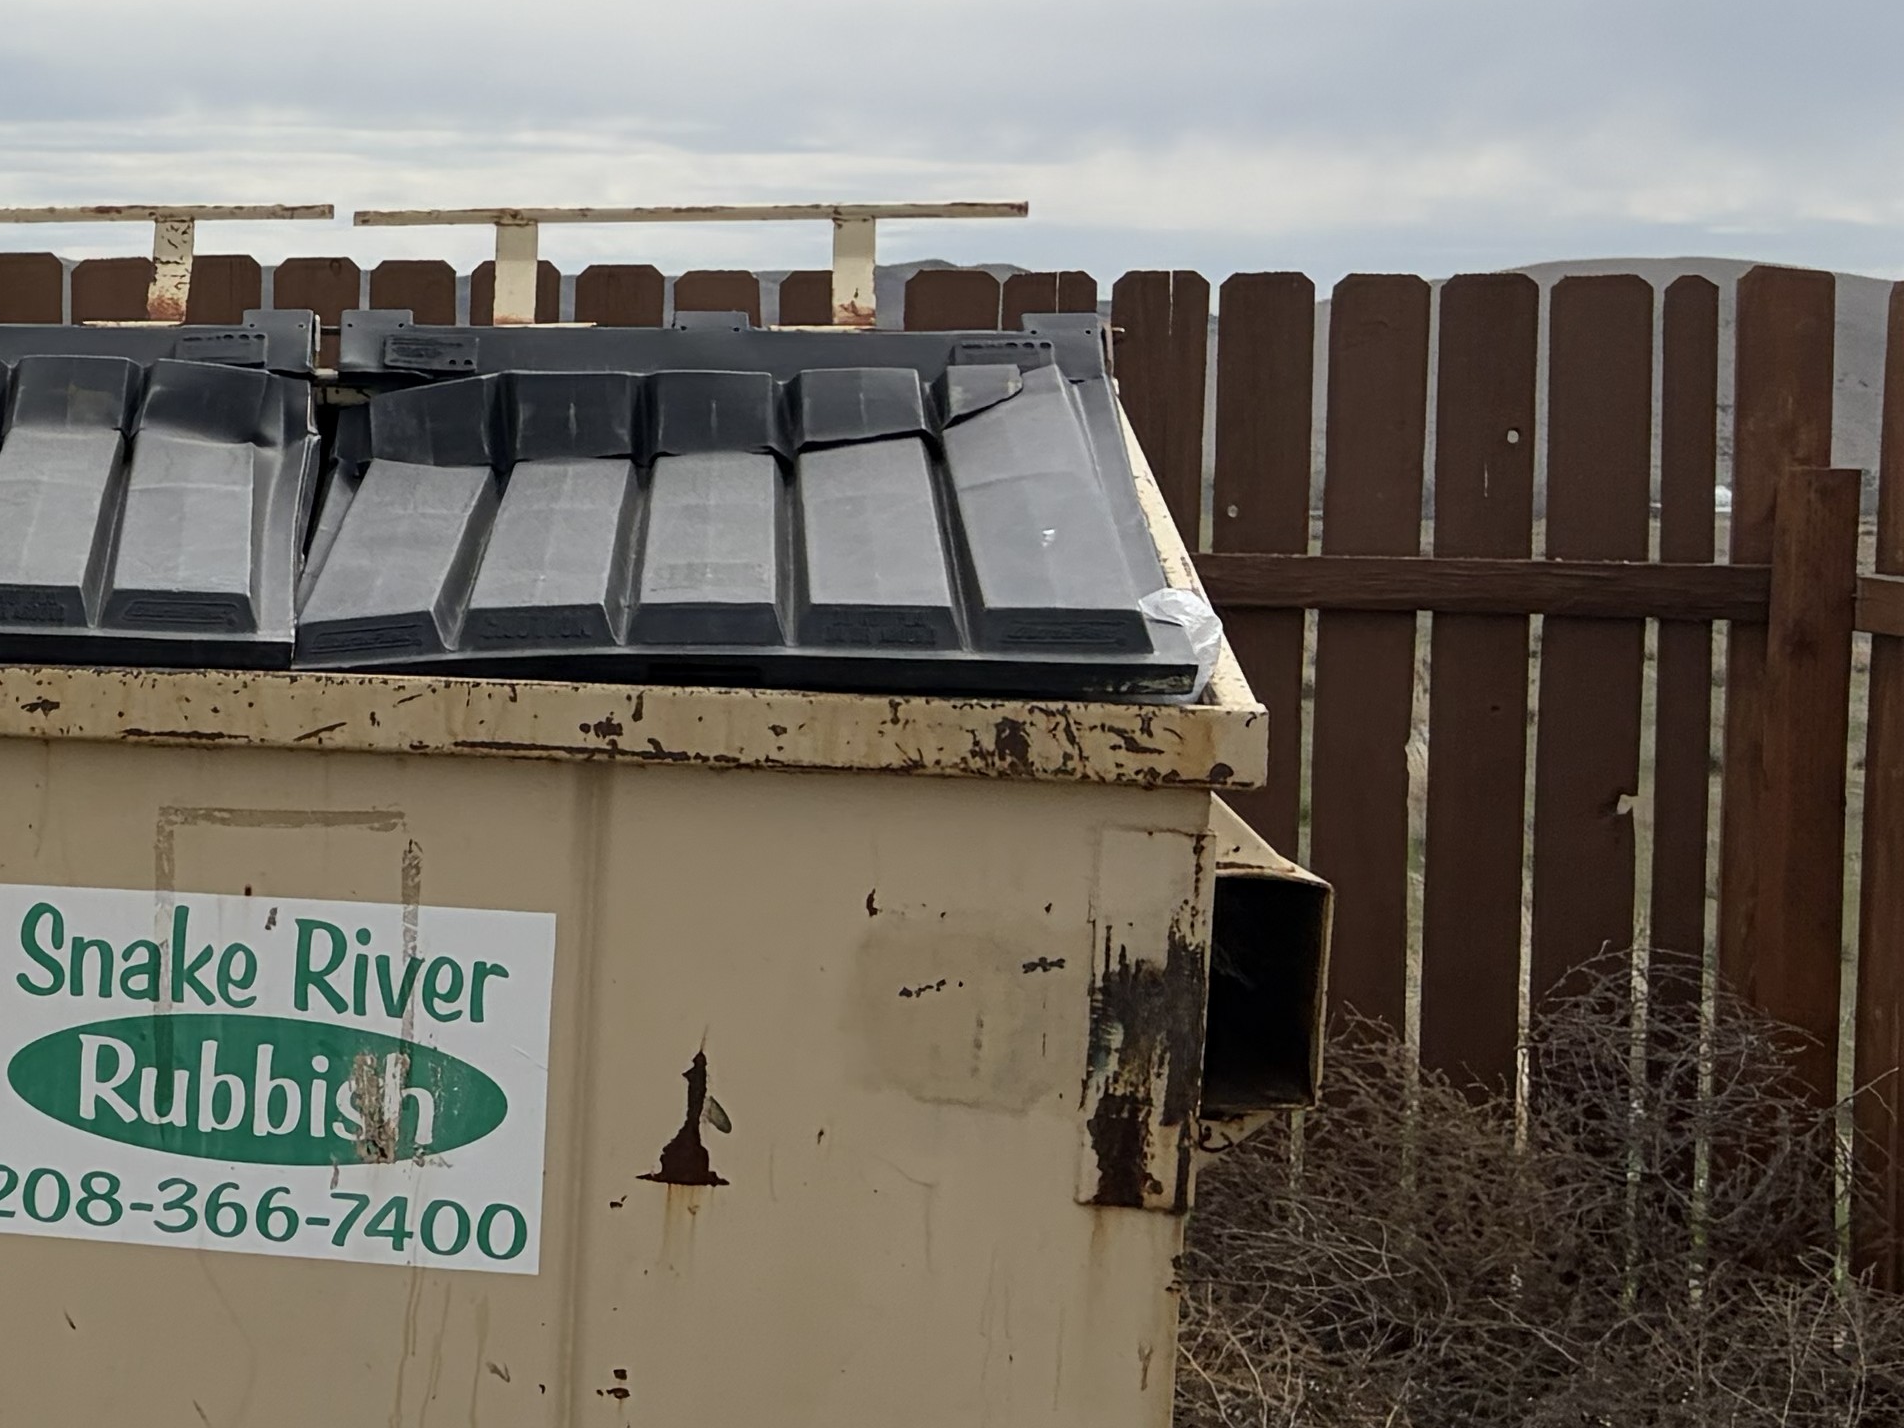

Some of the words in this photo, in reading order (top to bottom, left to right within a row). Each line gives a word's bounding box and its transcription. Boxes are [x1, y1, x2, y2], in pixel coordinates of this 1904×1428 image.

[15, 901, 260, 1009] Snake
[292, 916, 510, 1023] River
[77, 1032, 436, 1147] Rubbish
